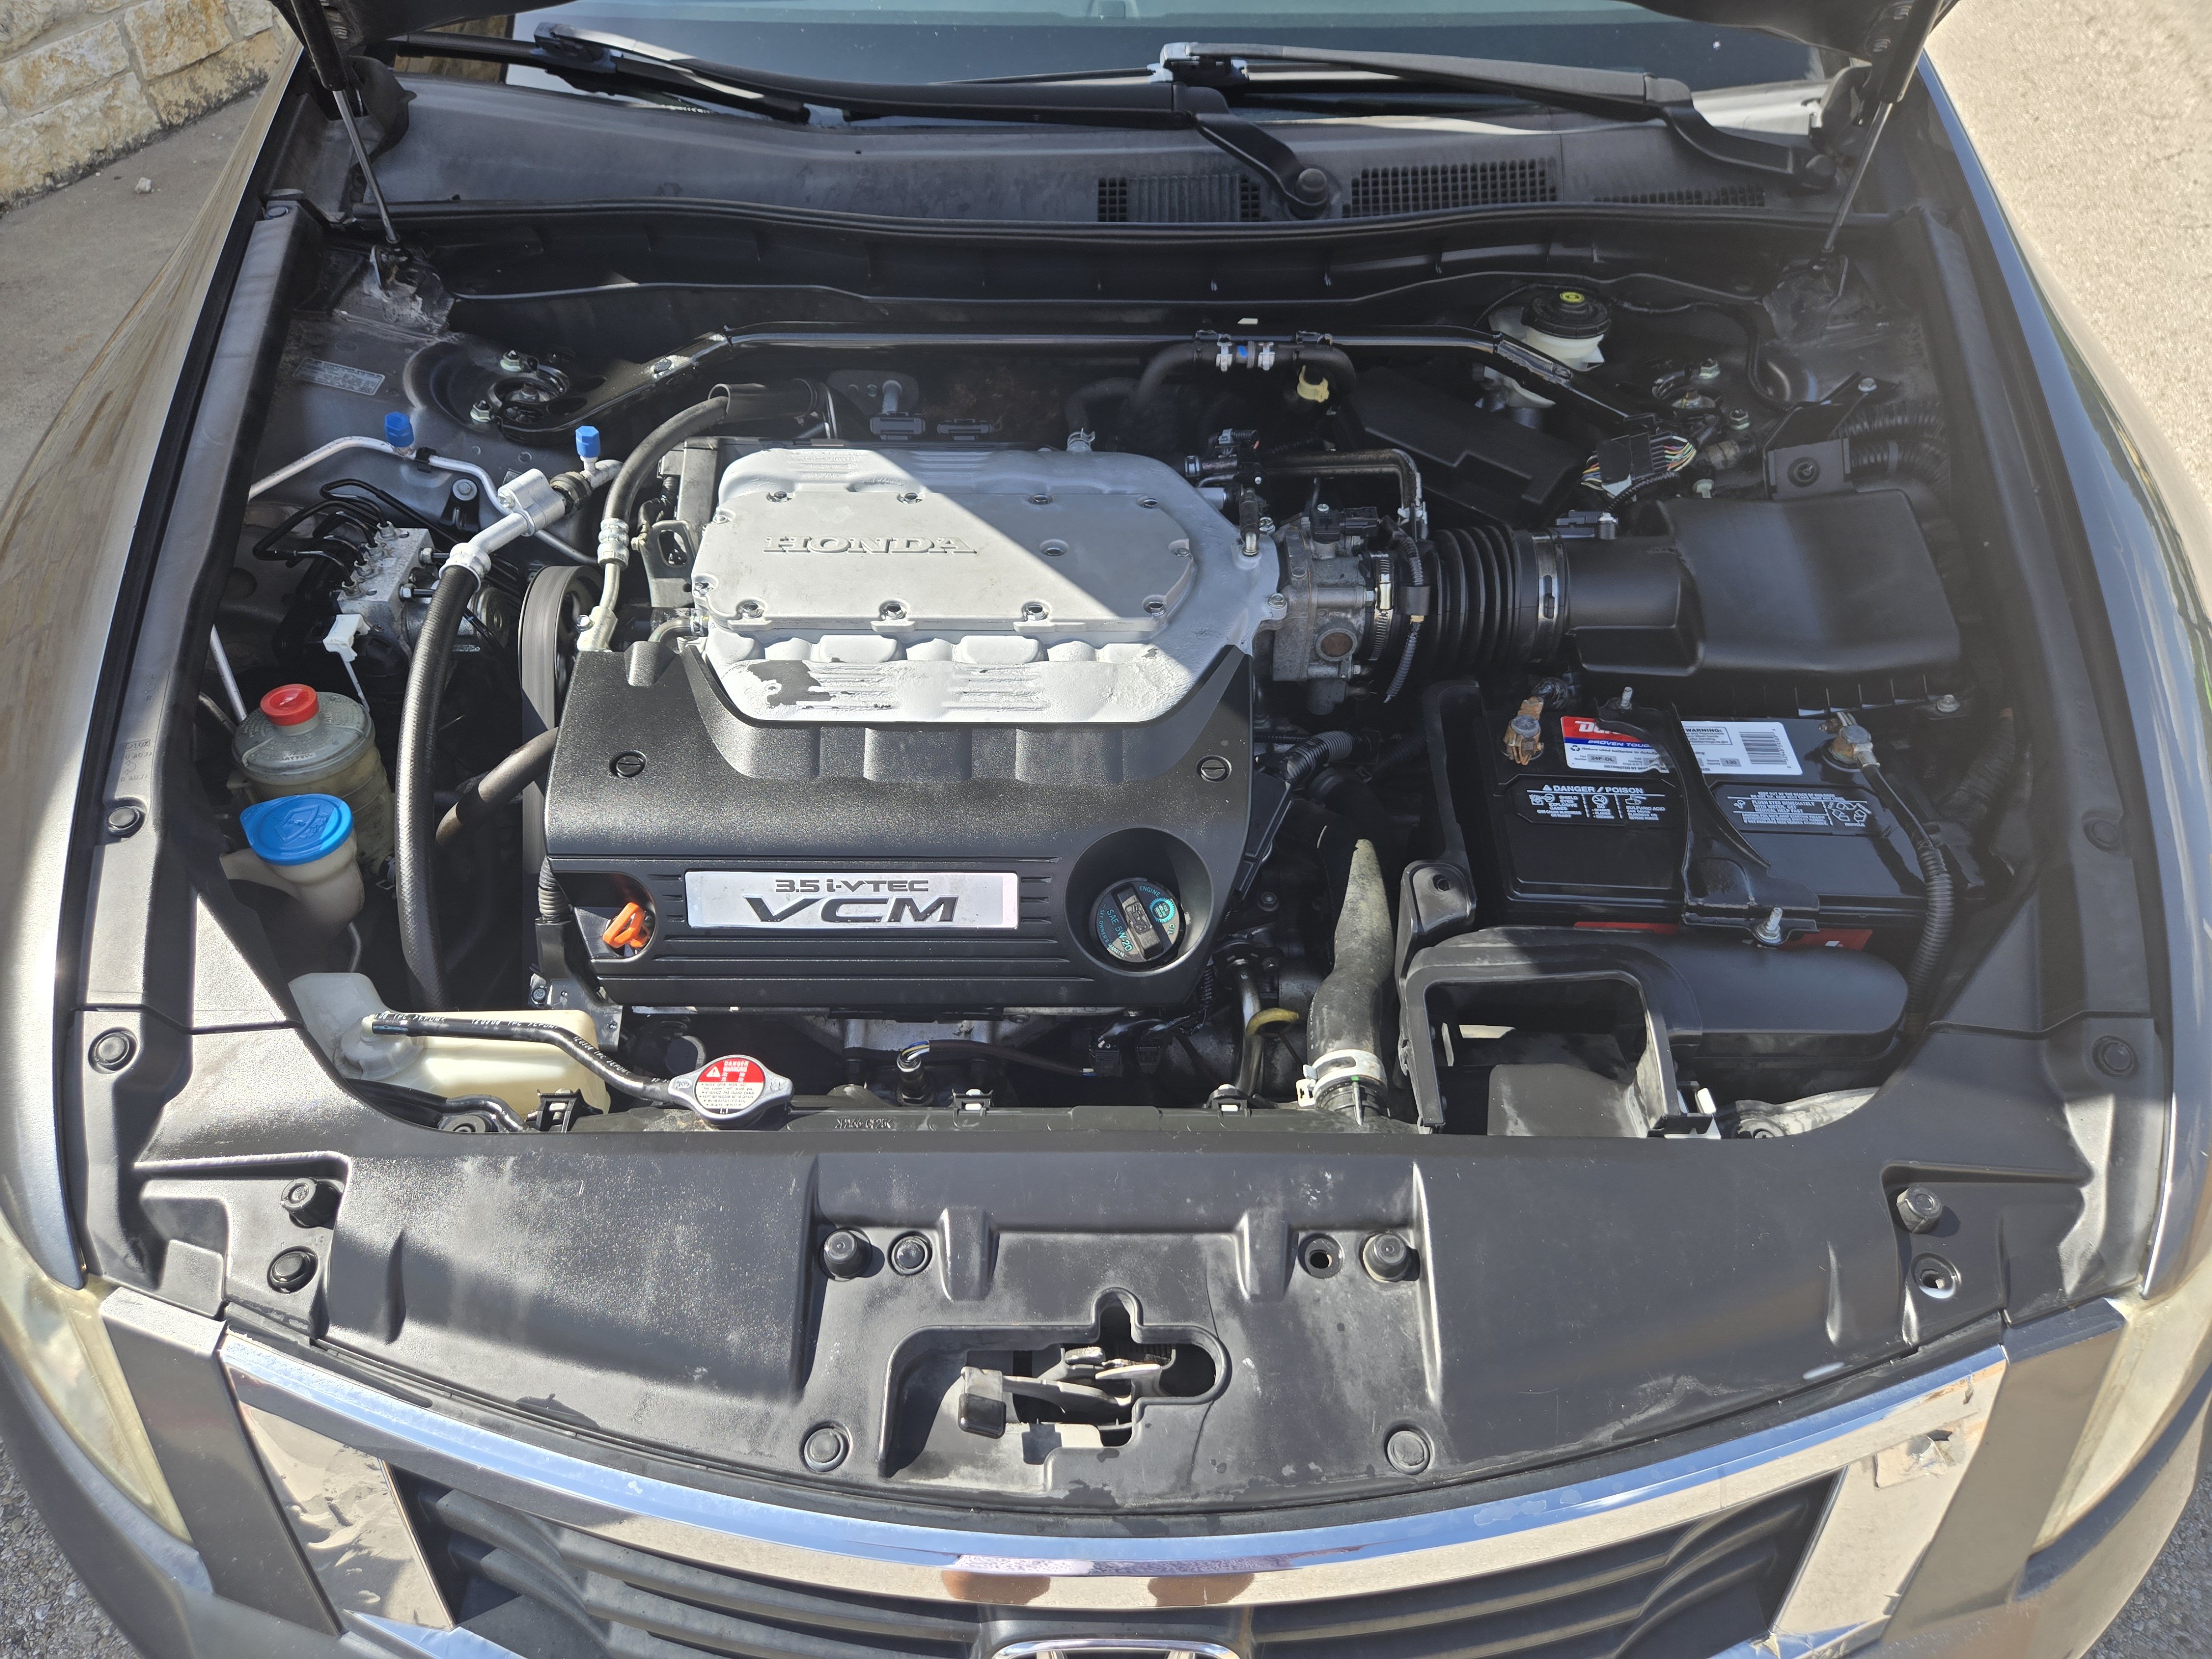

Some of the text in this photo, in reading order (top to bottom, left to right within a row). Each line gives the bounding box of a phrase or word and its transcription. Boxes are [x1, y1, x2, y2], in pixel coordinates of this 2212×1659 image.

[763, 535, 977, 554] HONDA
[775, 879, 929, 893] 3.5 i-VTEC
[1139, 885, 1162, 898] ENGINE
[743, 895, 959, 923] VCM
[1098, 921, 1109, 945] OWNER'S
[1107, 909, 1134, 952] SAE 5W-20
